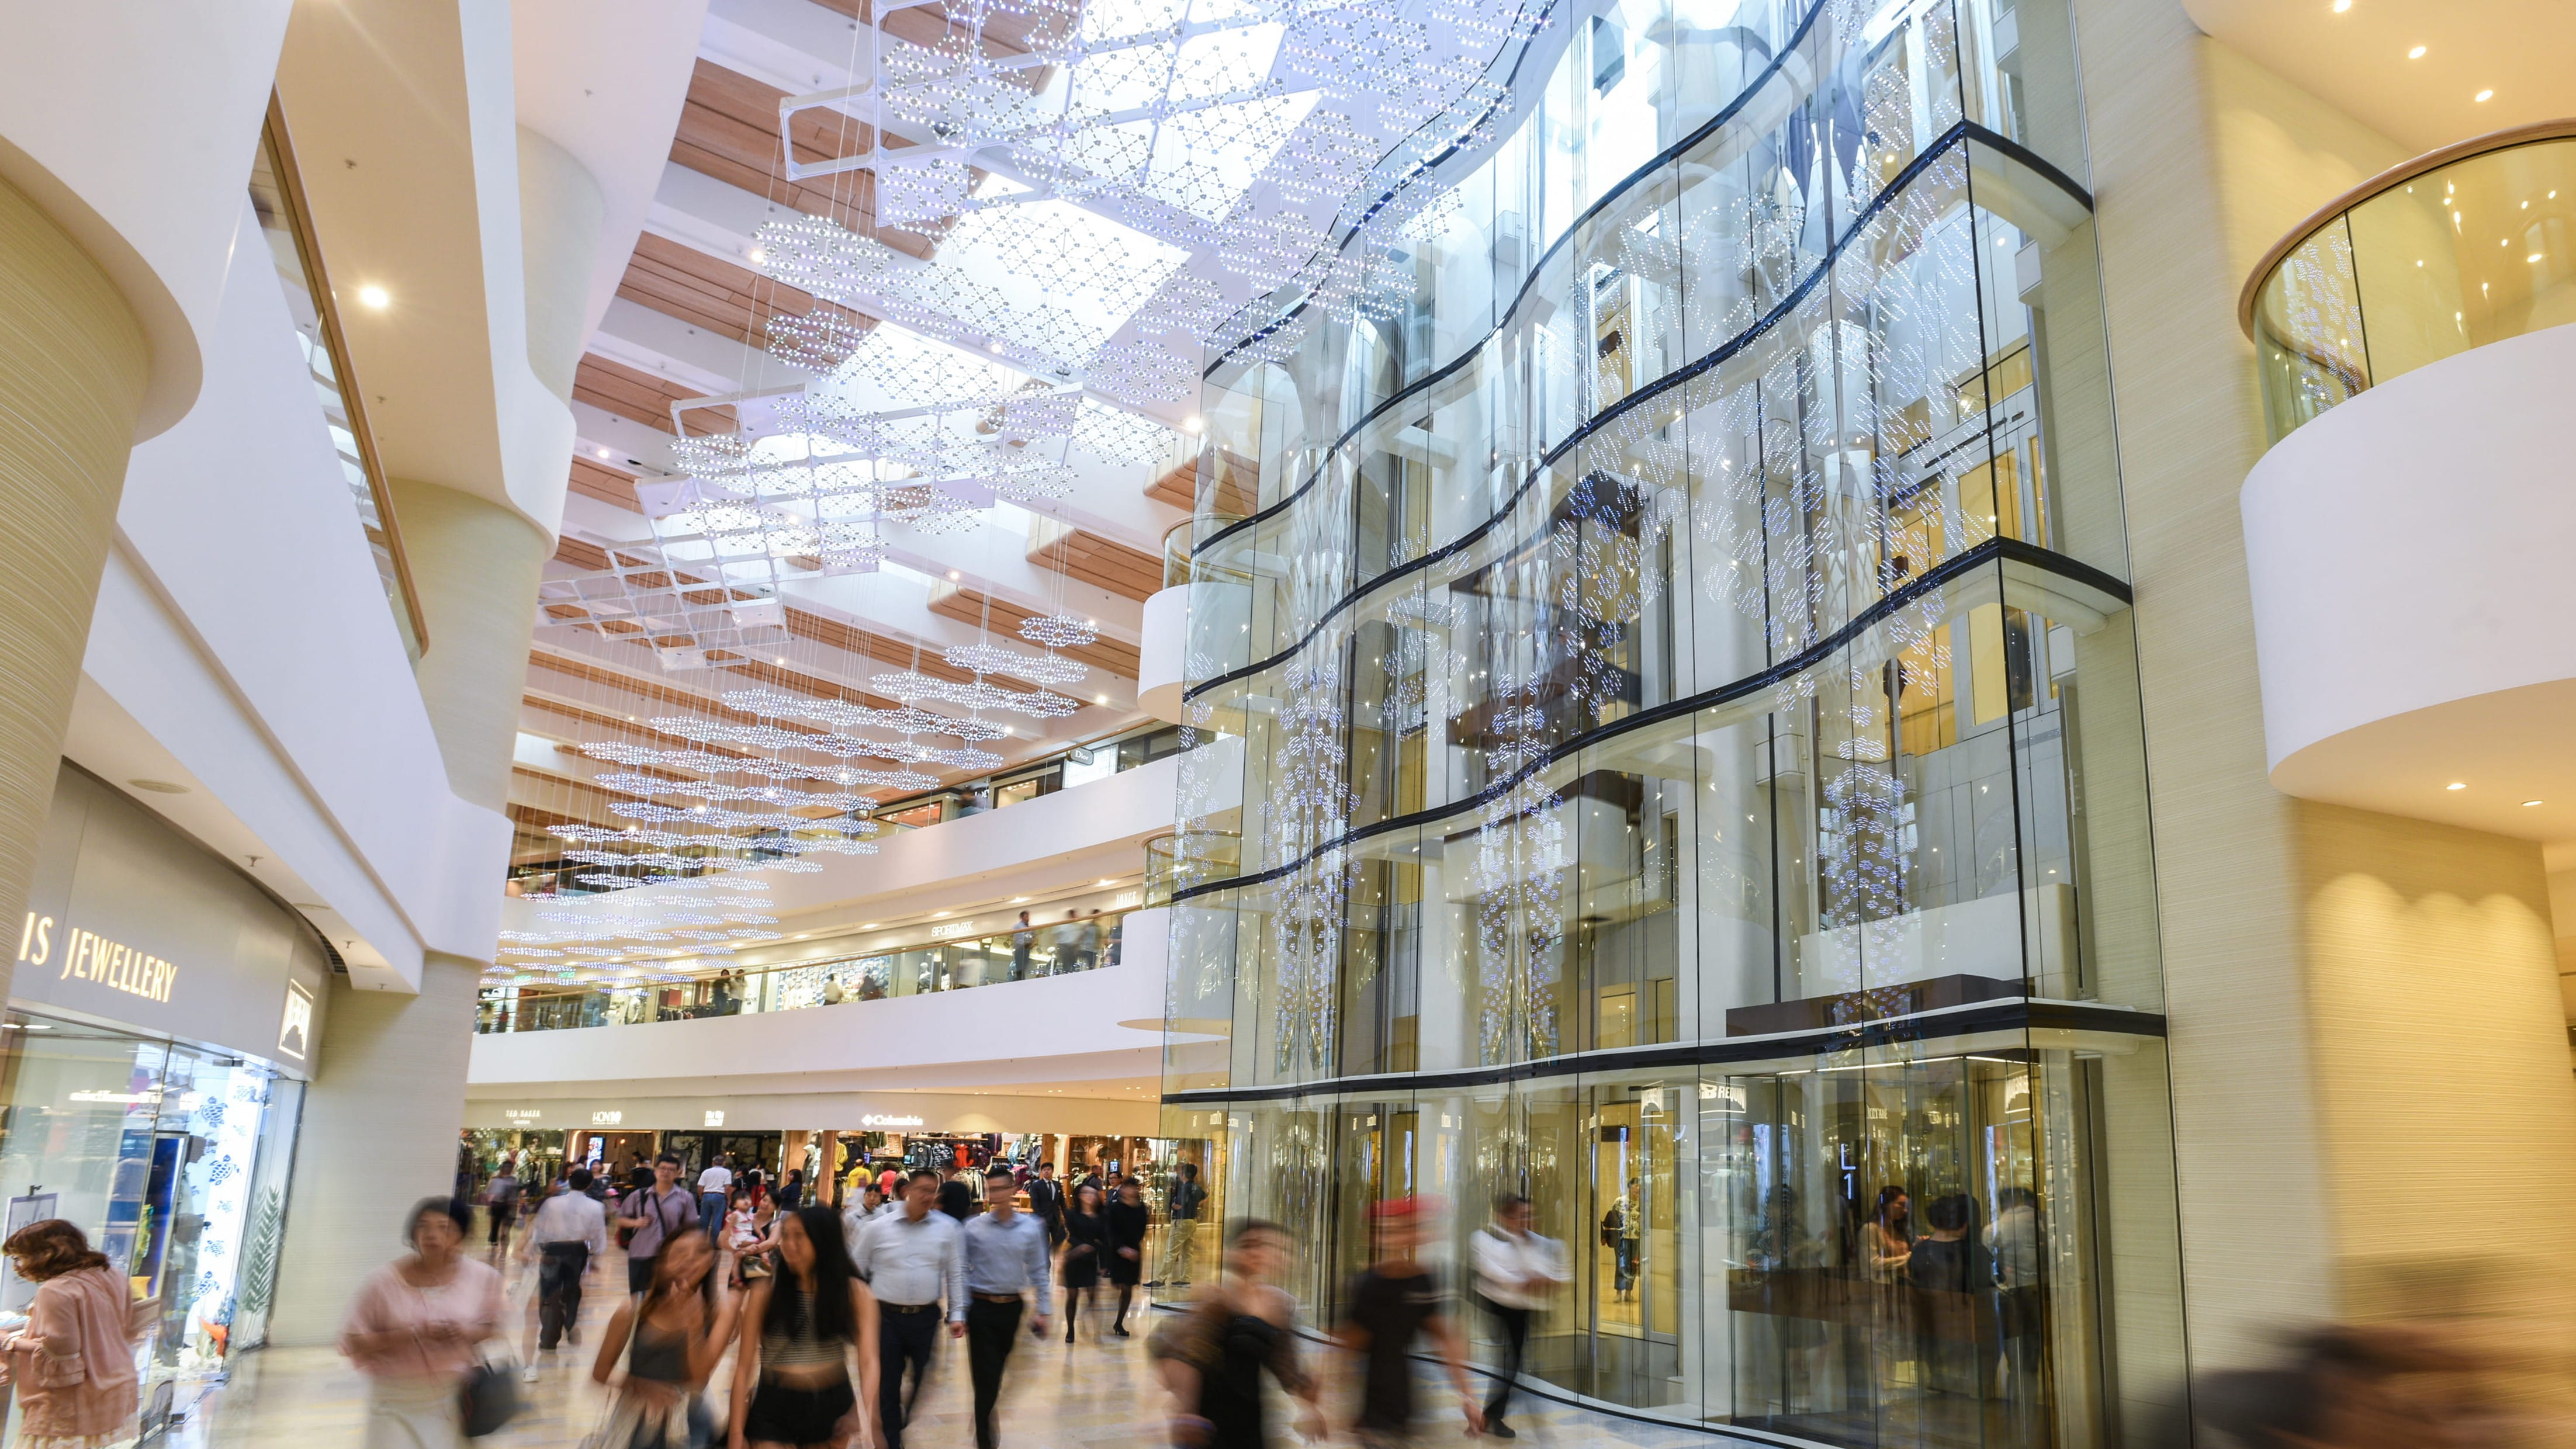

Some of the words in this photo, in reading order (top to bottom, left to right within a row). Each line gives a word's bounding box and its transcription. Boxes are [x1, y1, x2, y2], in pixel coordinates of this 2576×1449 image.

[1075, 750, 1088, 760] Dior
[931, 920, 974, 937] SPORTMAX
[60, 927, 178, 1003] JEWELLERY
[872, 1114, 923, 1126] Columbia
